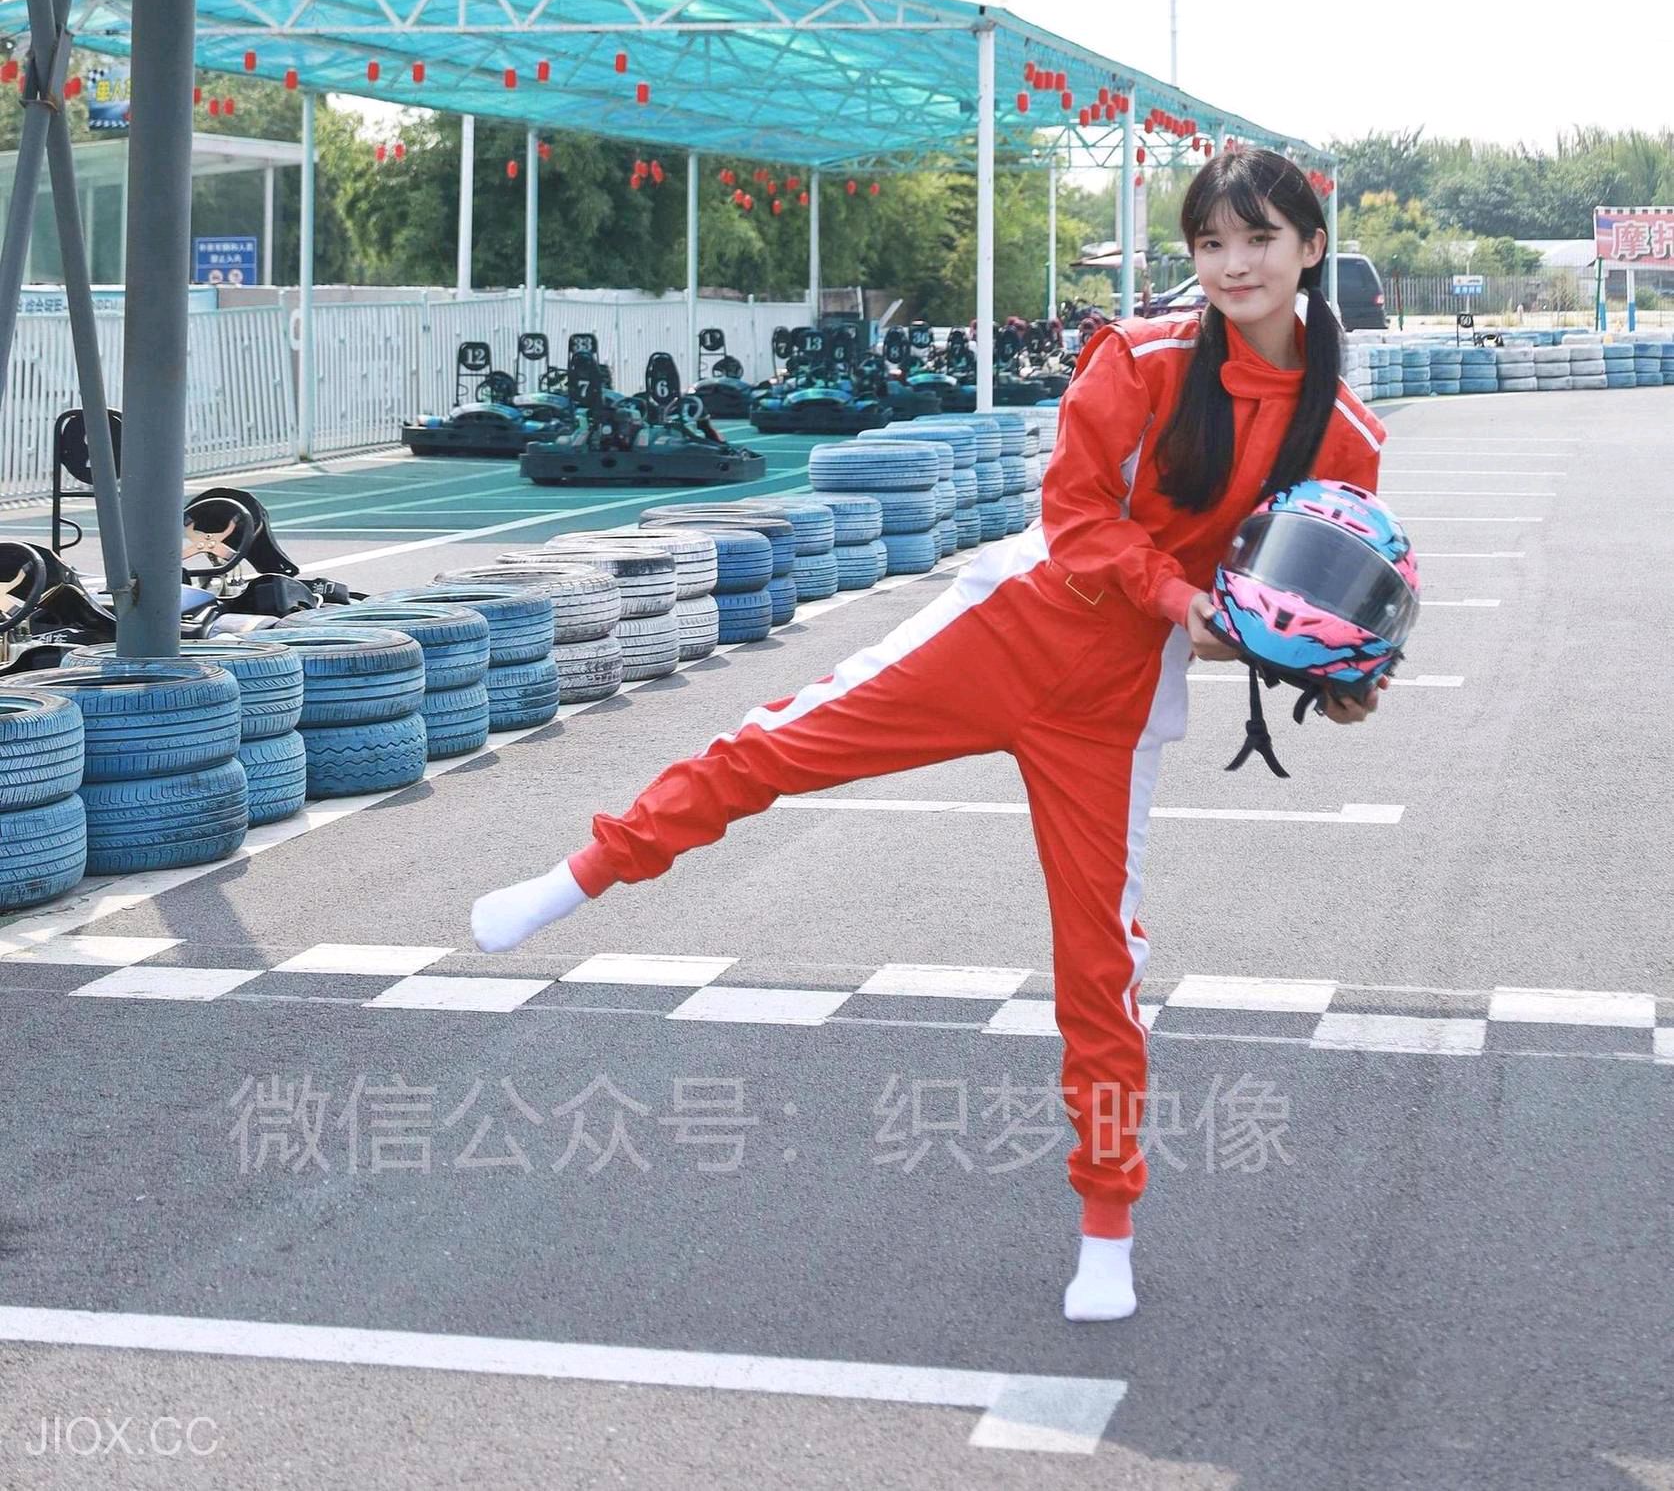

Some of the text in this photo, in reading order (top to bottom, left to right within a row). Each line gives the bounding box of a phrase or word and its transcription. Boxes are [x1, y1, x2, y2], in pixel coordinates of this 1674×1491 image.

[523, 338, 545, 354] 28
[805, 337, 823, 351] 13
[466, 349, 486, 365] 12
[578, 380, 590, 398] 7
[656, 380, 669, 397] 6
